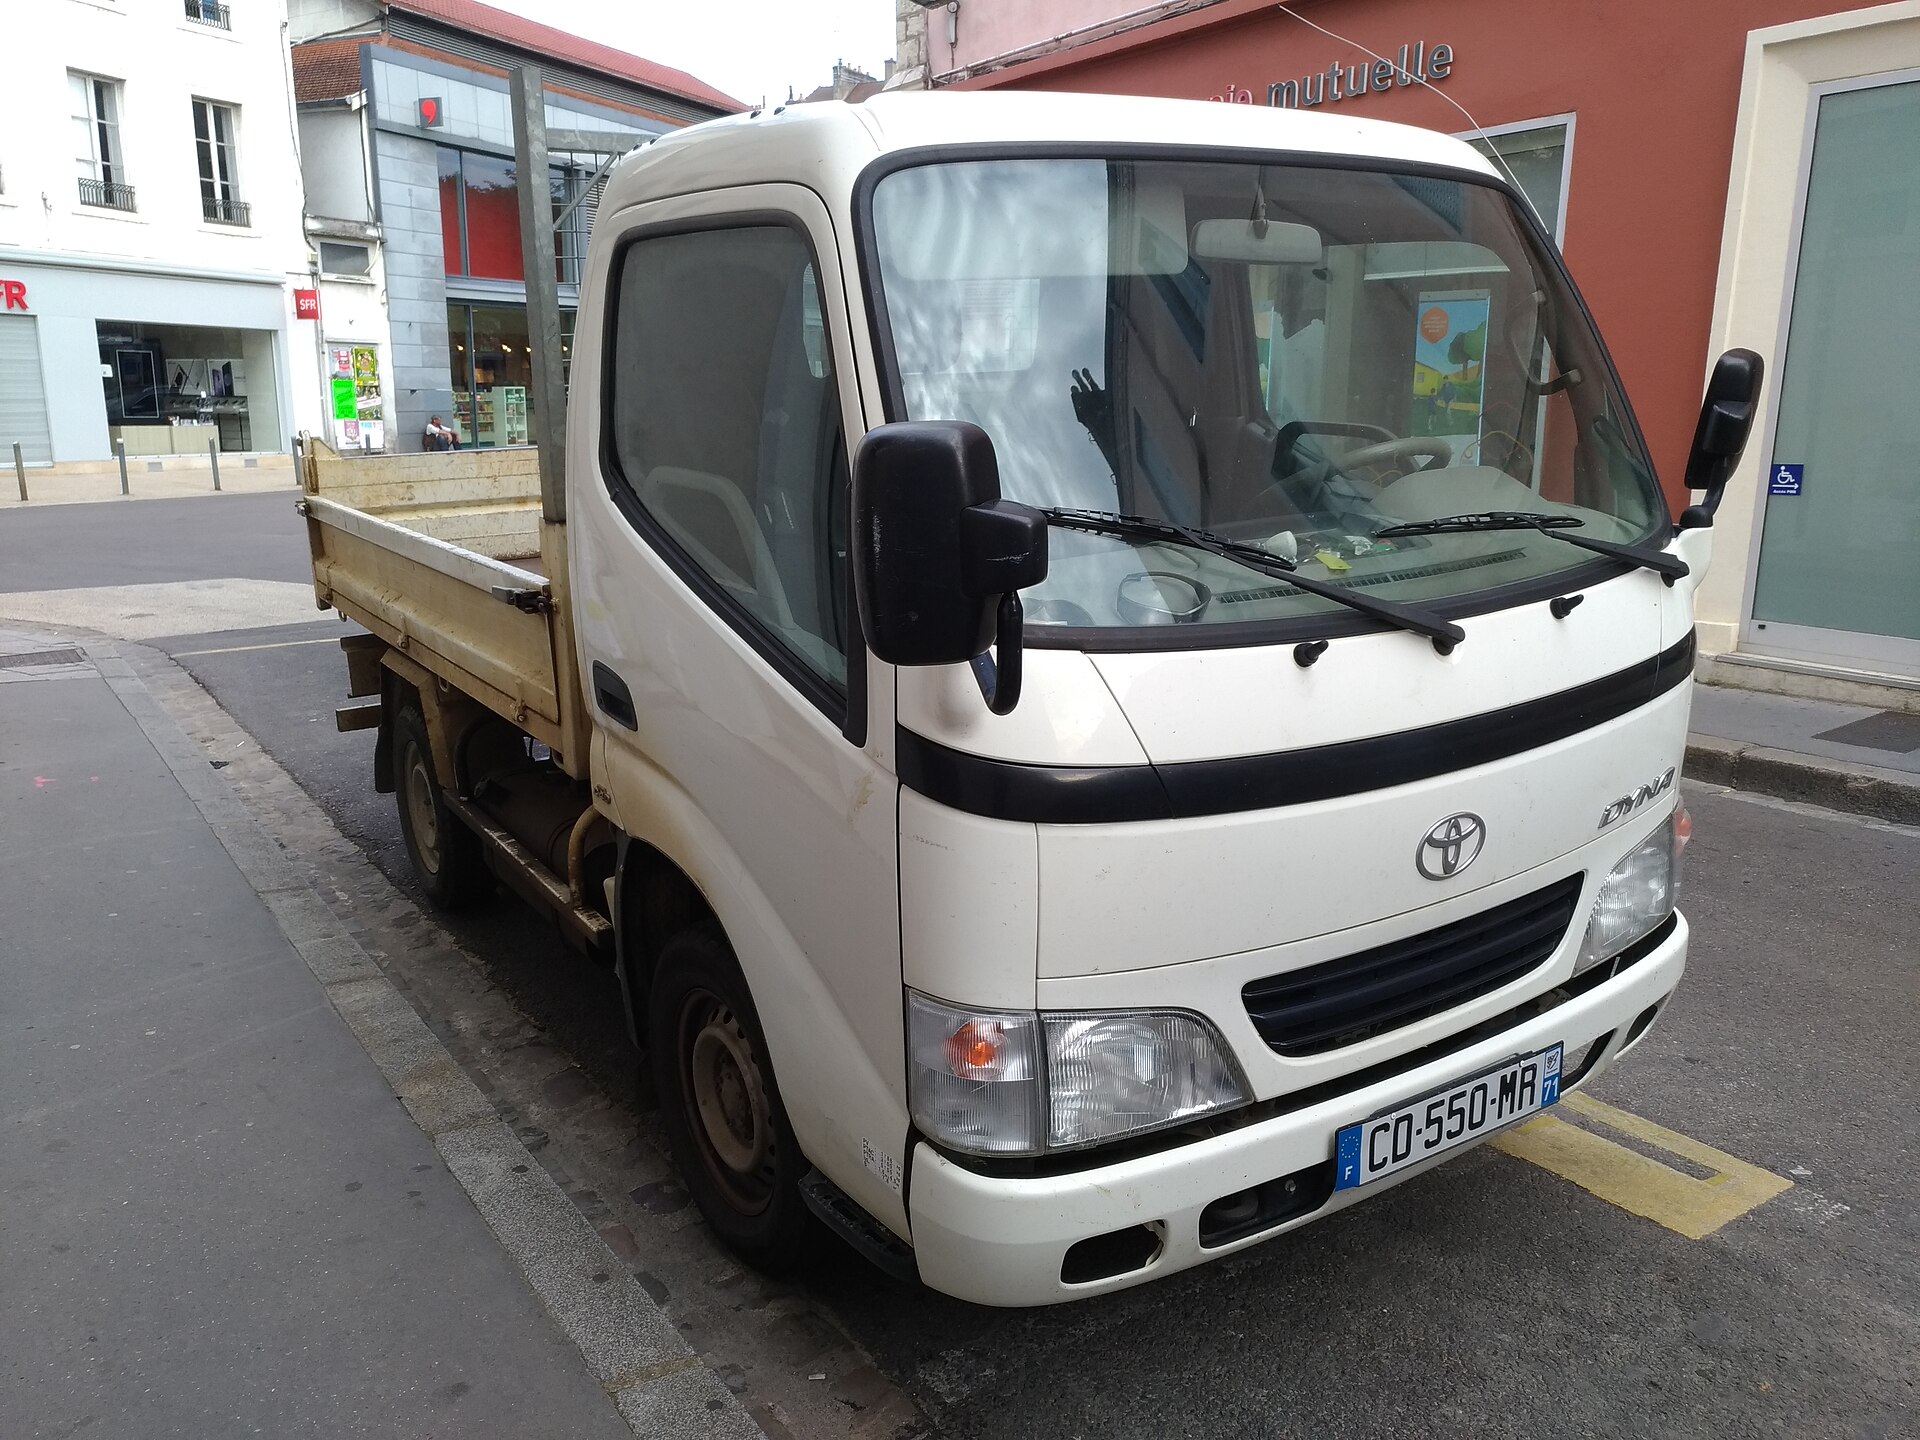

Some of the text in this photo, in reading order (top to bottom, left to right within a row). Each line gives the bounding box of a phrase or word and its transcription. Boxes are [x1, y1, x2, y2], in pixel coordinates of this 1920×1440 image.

[1267, 40, 1454, 109] mutuelle
[0, 279, 29, 311] R
[299, 298, 317, 311] SFR
[1597, 766, 1675, 829] DYNA
[1544, 1076, 1559, 1102] 71
[1344, 1062, 1538, 1181] F CD-550-MR
